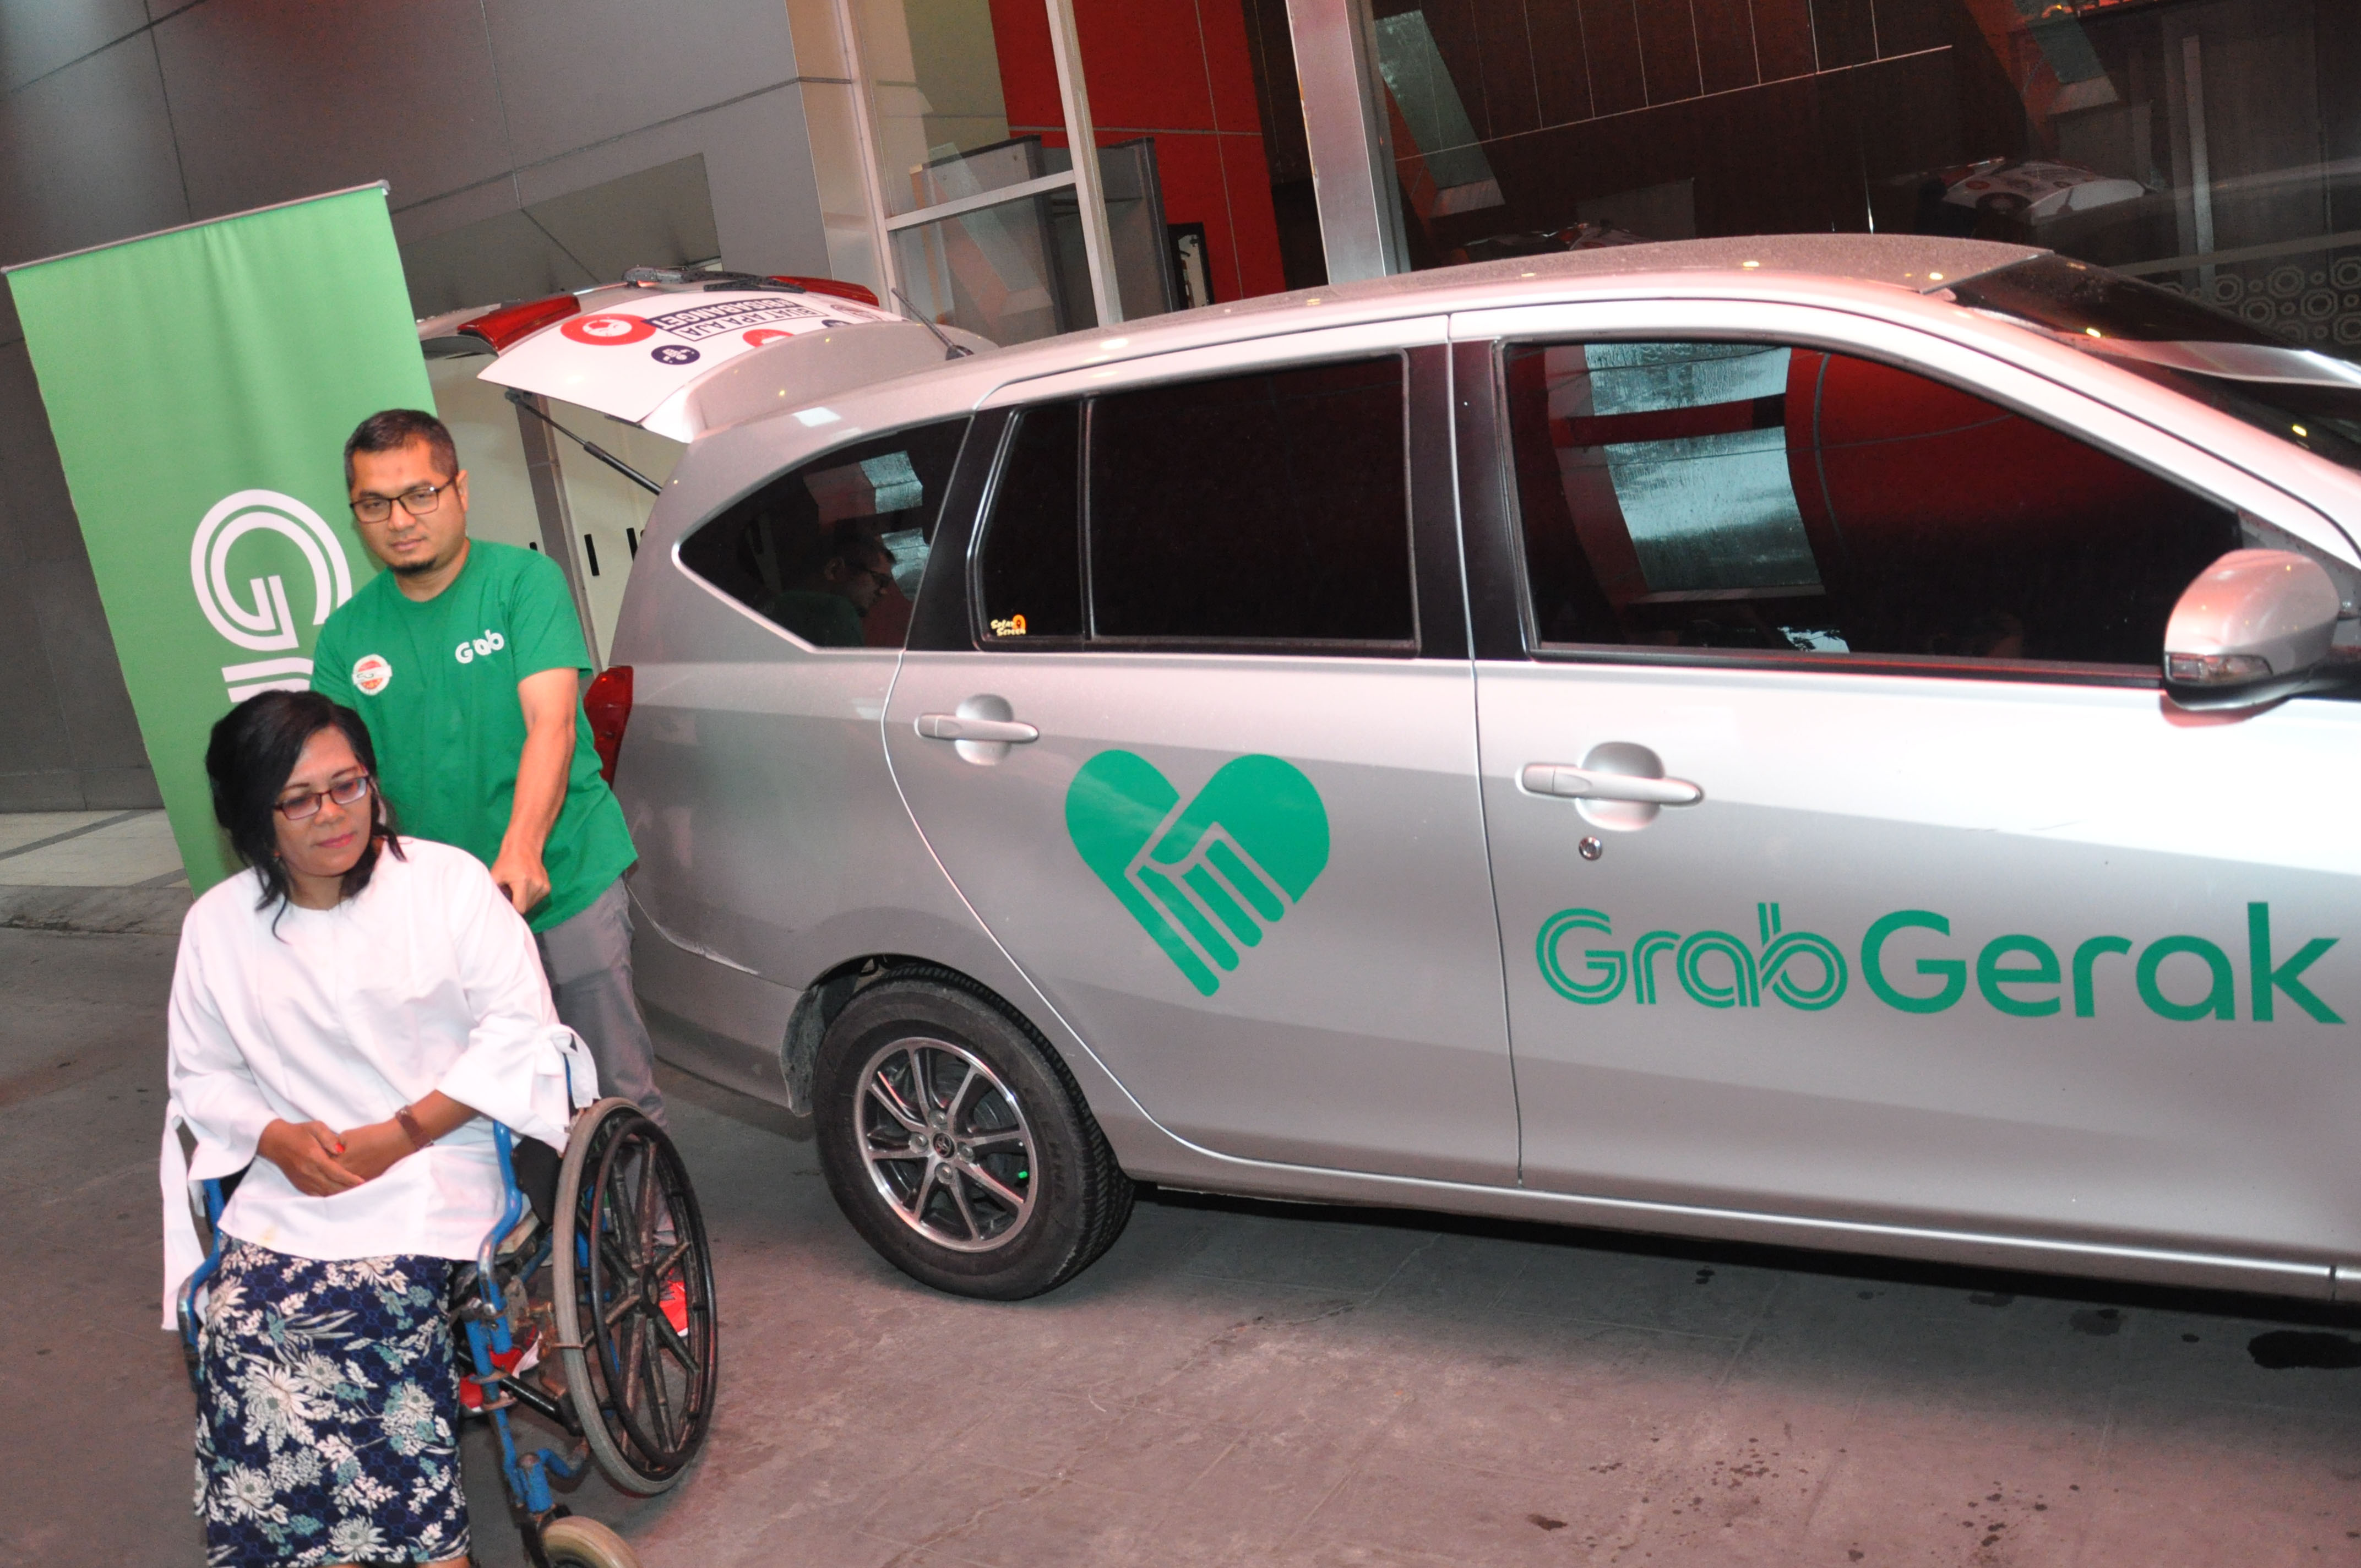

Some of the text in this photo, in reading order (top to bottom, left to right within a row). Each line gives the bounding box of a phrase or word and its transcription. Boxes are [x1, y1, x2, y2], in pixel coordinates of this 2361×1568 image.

[679, 308, 818, 336] BUAT APA AJA
